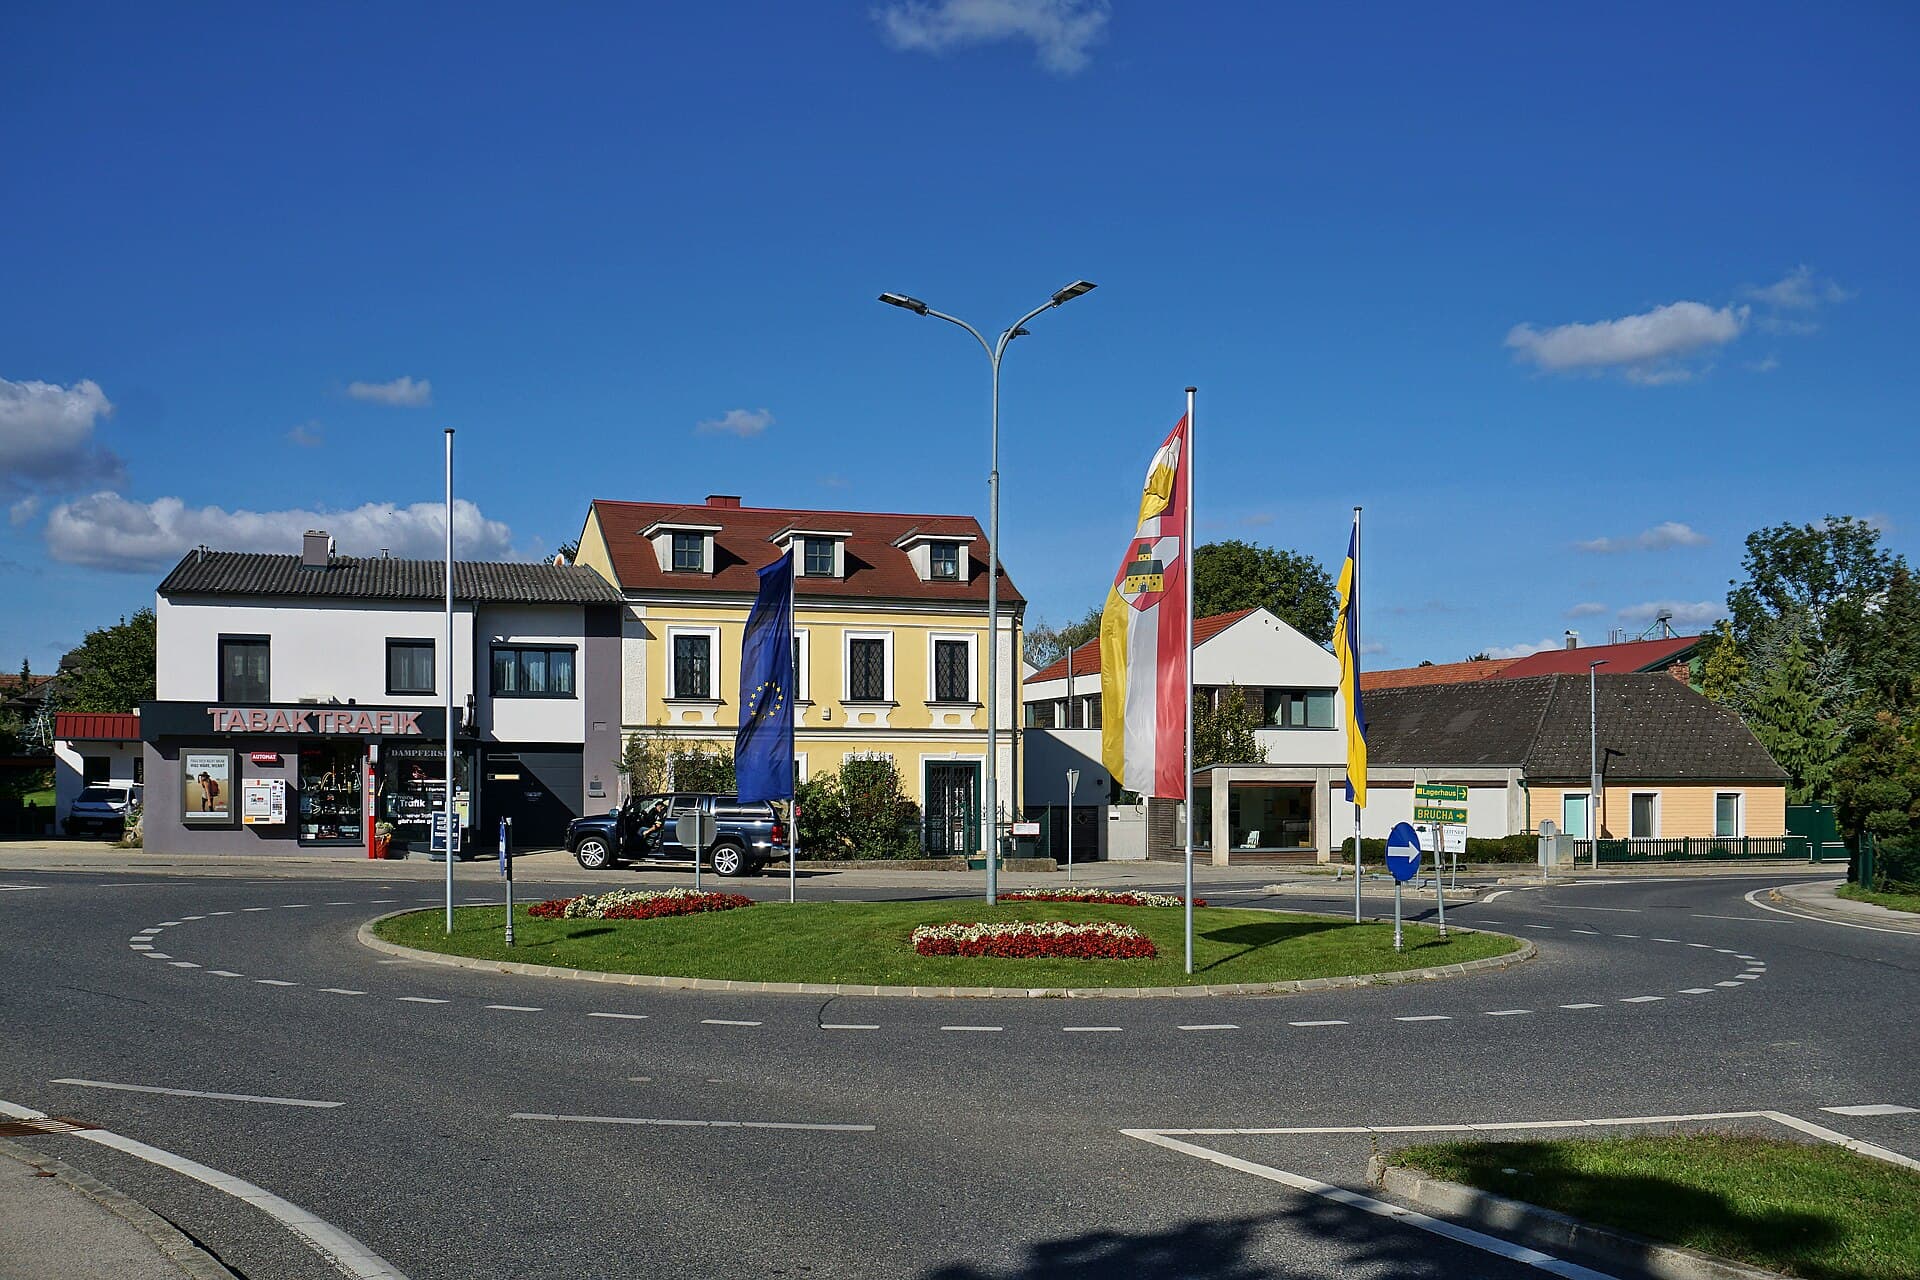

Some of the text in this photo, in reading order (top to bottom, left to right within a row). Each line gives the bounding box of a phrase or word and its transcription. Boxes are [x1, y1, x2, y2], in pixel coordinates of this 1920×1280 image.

[391, 749, 462, 757] DAMPFERSP
[1422, 788, 1456, 796] Lagerhaus
[400, 799, 426, 807] Trafik
[1417, 809, 1454, 820] BRUCHA
